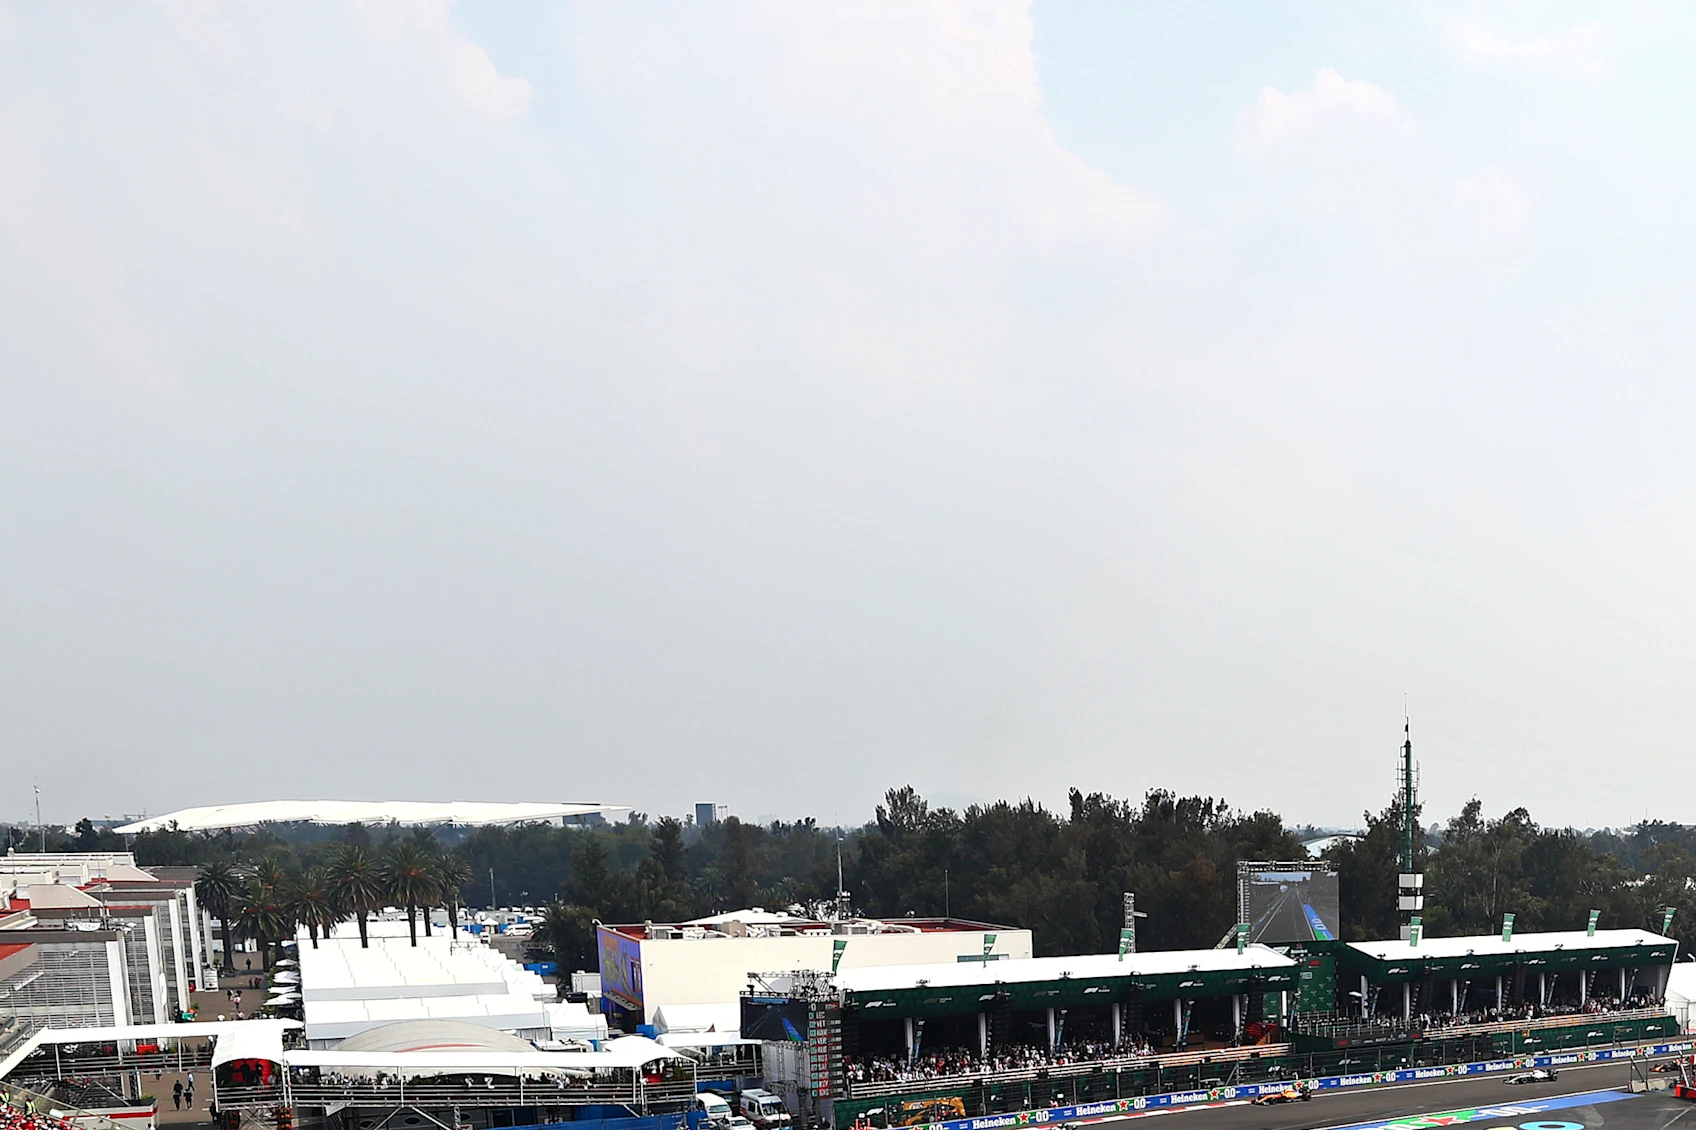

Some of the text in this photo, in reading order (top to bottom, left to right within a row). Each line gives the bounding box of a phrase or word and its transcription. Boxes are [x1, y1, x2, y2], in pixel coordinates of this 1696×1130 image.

[1552, 1055, 1577, 1064] Heineken
[1486, 1062, 1514, 1072] Heineken
[1416, 1068, 1445, 1078] Heineken
[1340, 1076, 1372, 1086] Heineken
[1171, 1092, 1208, 1104] Heineken
[1076, 1104, 1116, 1116] Heineken
[973, 1117, 1016, 1130] Heineken
